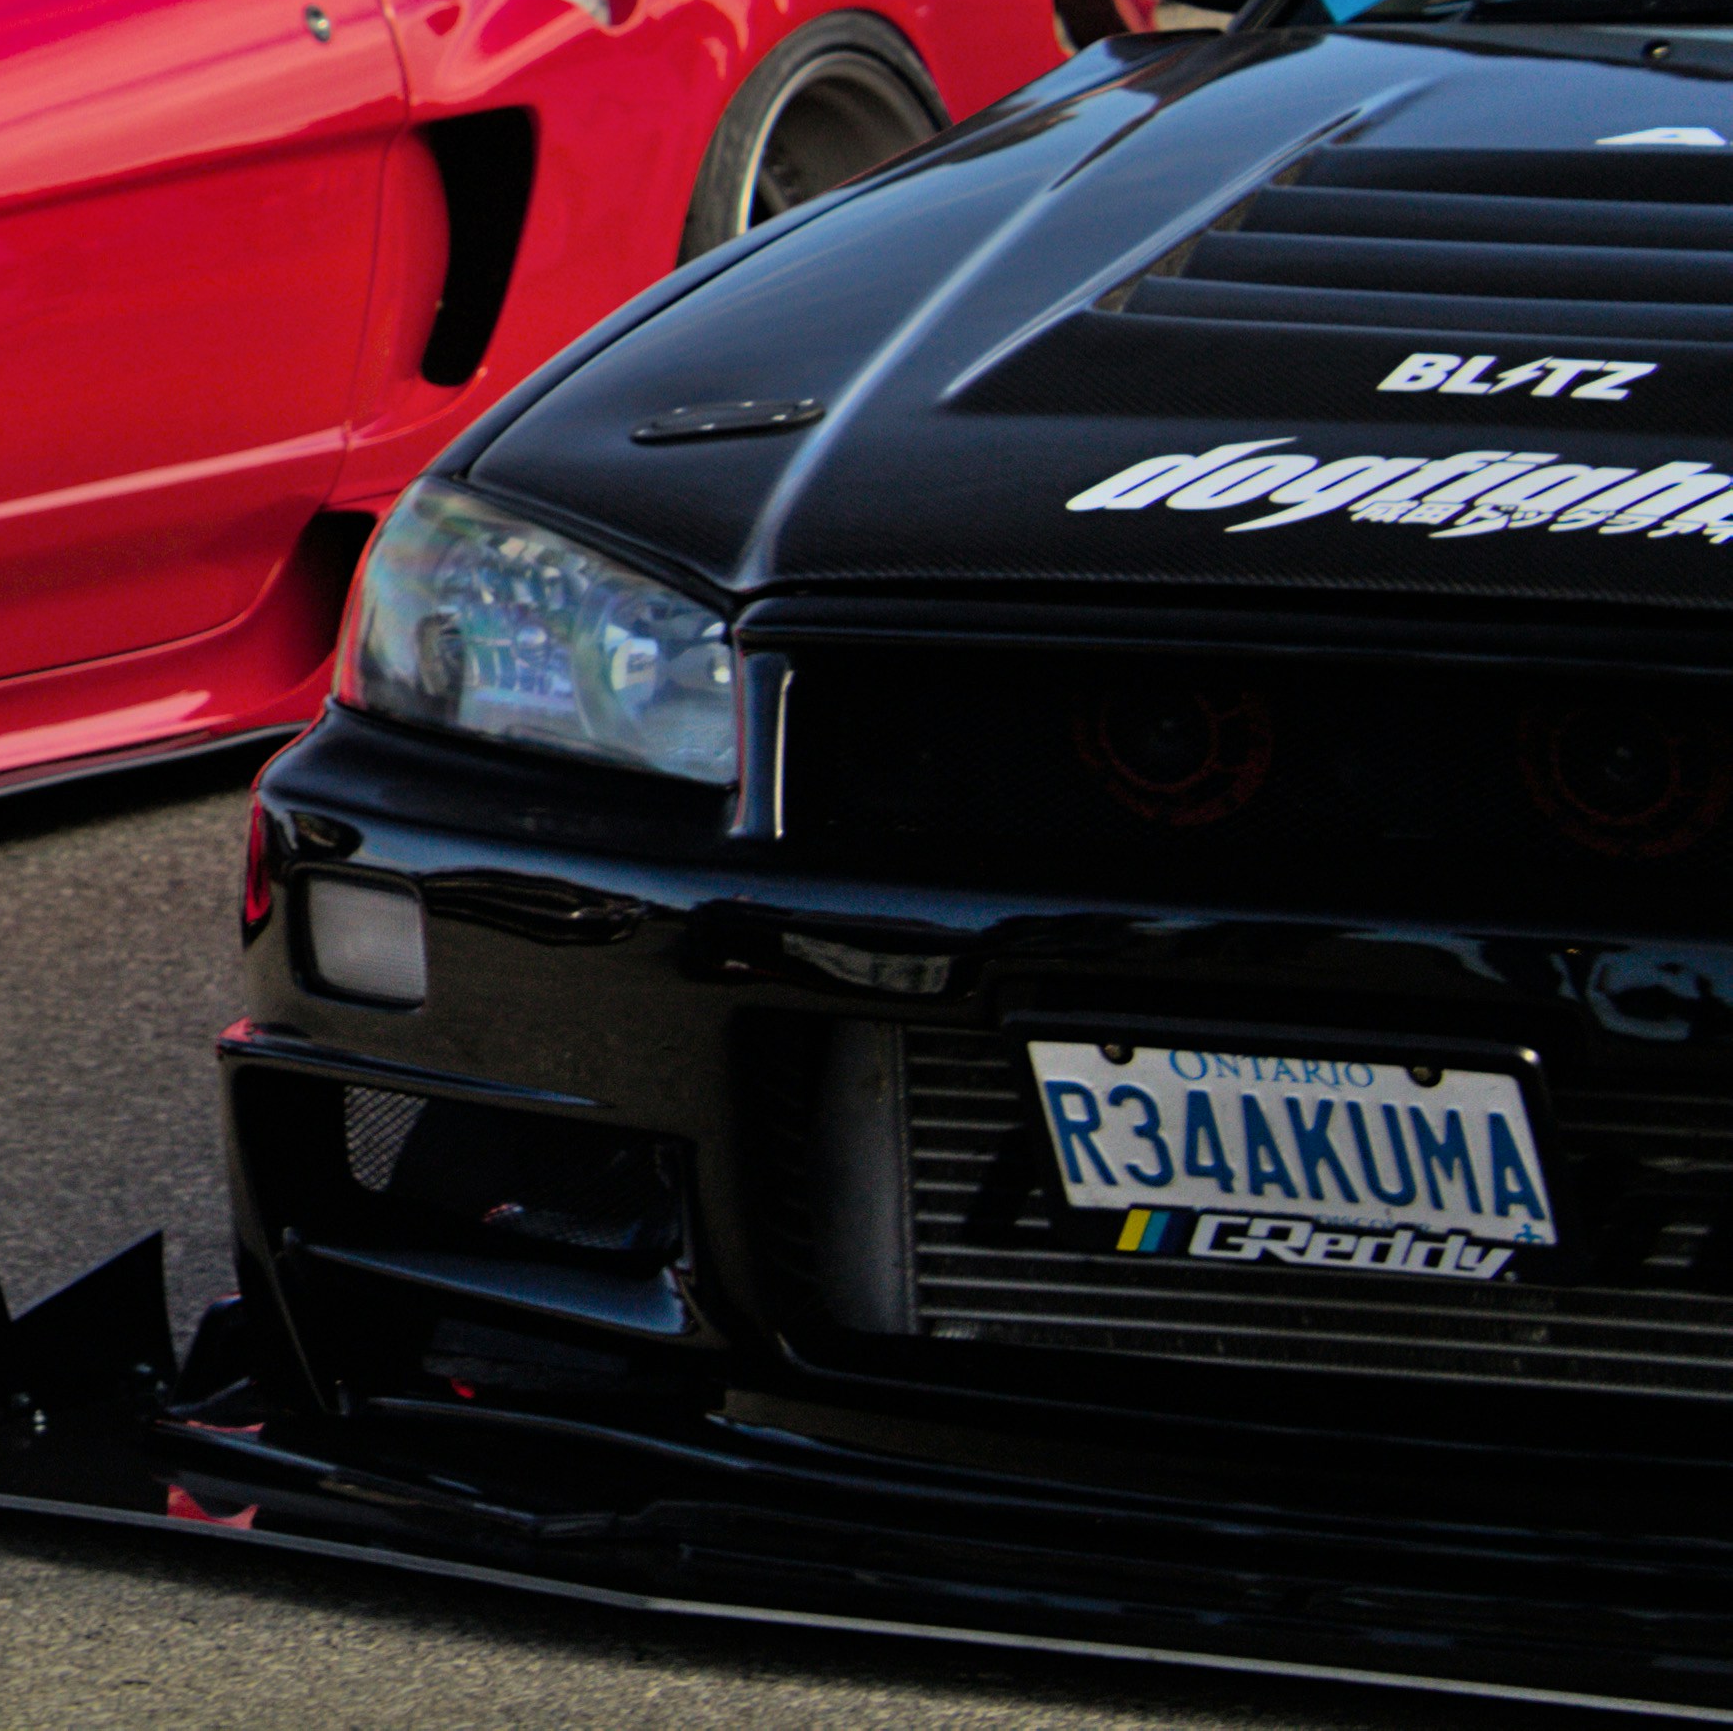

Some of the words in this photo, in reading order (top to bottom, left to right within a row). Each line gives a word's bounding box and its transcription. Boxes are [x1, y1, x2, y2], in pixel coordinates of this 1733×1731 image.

[1376, 352, 1659, 401] BLITZ
[1167, 1048, 1376, 1090] ONTARIO
[1043, 1078, 1546, 1222] R34AKUMA
[1187, 1212, 1517, 1281] GReddy
